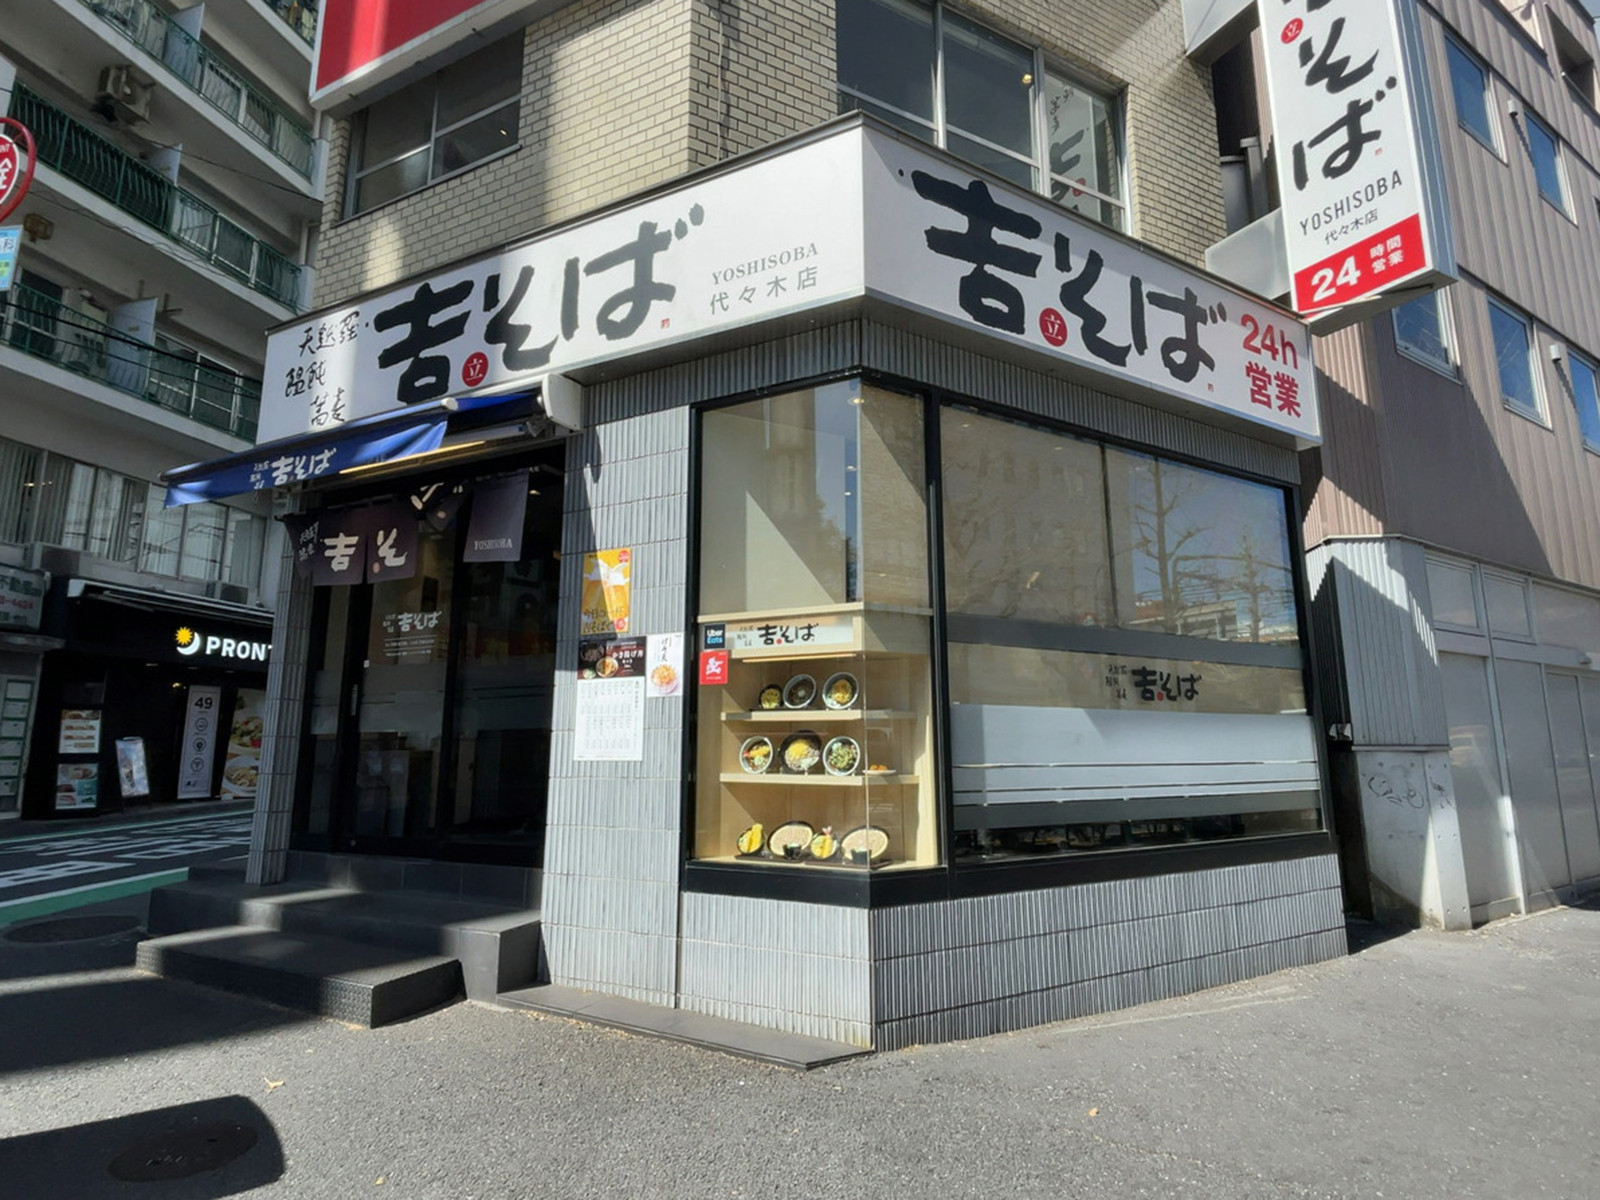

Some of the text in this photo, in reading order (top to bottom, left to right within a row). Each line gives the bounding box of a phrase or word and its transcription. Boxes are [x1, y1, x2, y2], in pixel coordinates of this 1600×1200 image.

[1299, 169, 1403, 237] YOSHISOBA
[1324, 208, 1379, 245] 代々木店
[710, 241, 820, 286] YOSHISOBA
[1369, 234, 1402, 260] 時間
[1371, 252, 1404, 275] 営業
[709, 265, 820, 316] 代々木店
[911, 168, 1227, 384] 吉そば
[1311, 255, 1362, 303] 24
[373, 203, 705, 404] 吉そば
[1240, 313, 1299, 371] 24h
[1244, 360, 1302, 419] 営業
[271, 447, 337, 486] 吉そば
[706, 628, 724, 637] Uber
[706, 636, 723, 645] Eats
[757, 622, 820, 646] 吉そば
[194, 696, 213, 710] 49
[1131, 666, 1202, 701] 吉そば
